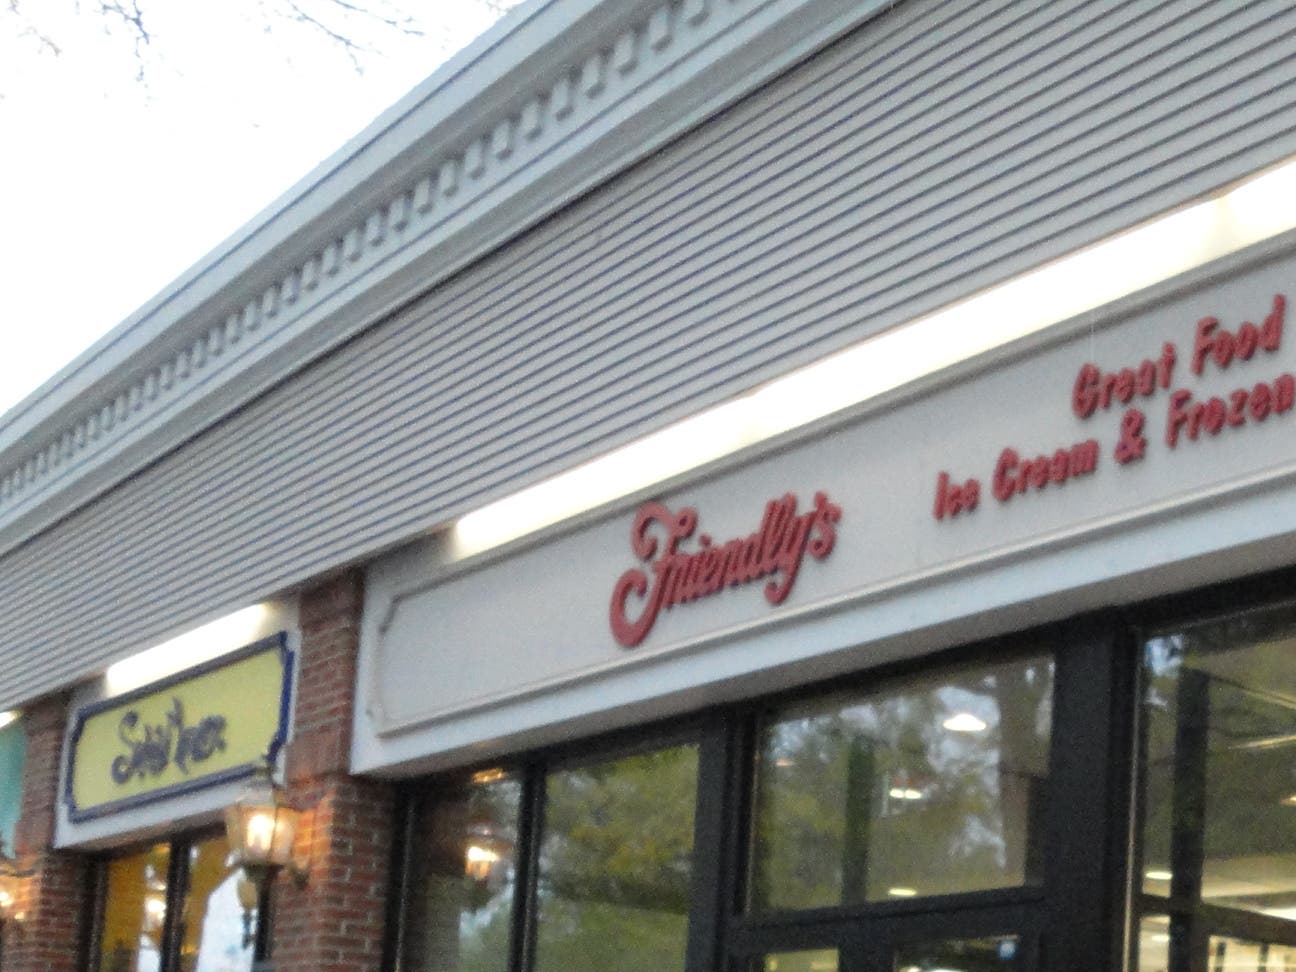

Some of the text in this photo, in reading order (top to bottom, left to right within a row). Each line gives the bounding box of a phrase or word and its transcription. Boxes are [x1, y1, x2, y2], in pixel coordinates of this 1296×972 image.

[1073, 293, 1286, 420] Great Food
[933, 471, 981, 520] Ice
[993, 439, 1100, 501] Cream
[1114, 408, 1147, 465] &
[1166, 373, 1296, 449] Frozen
[609, 490, 842, 647] Friendly's
